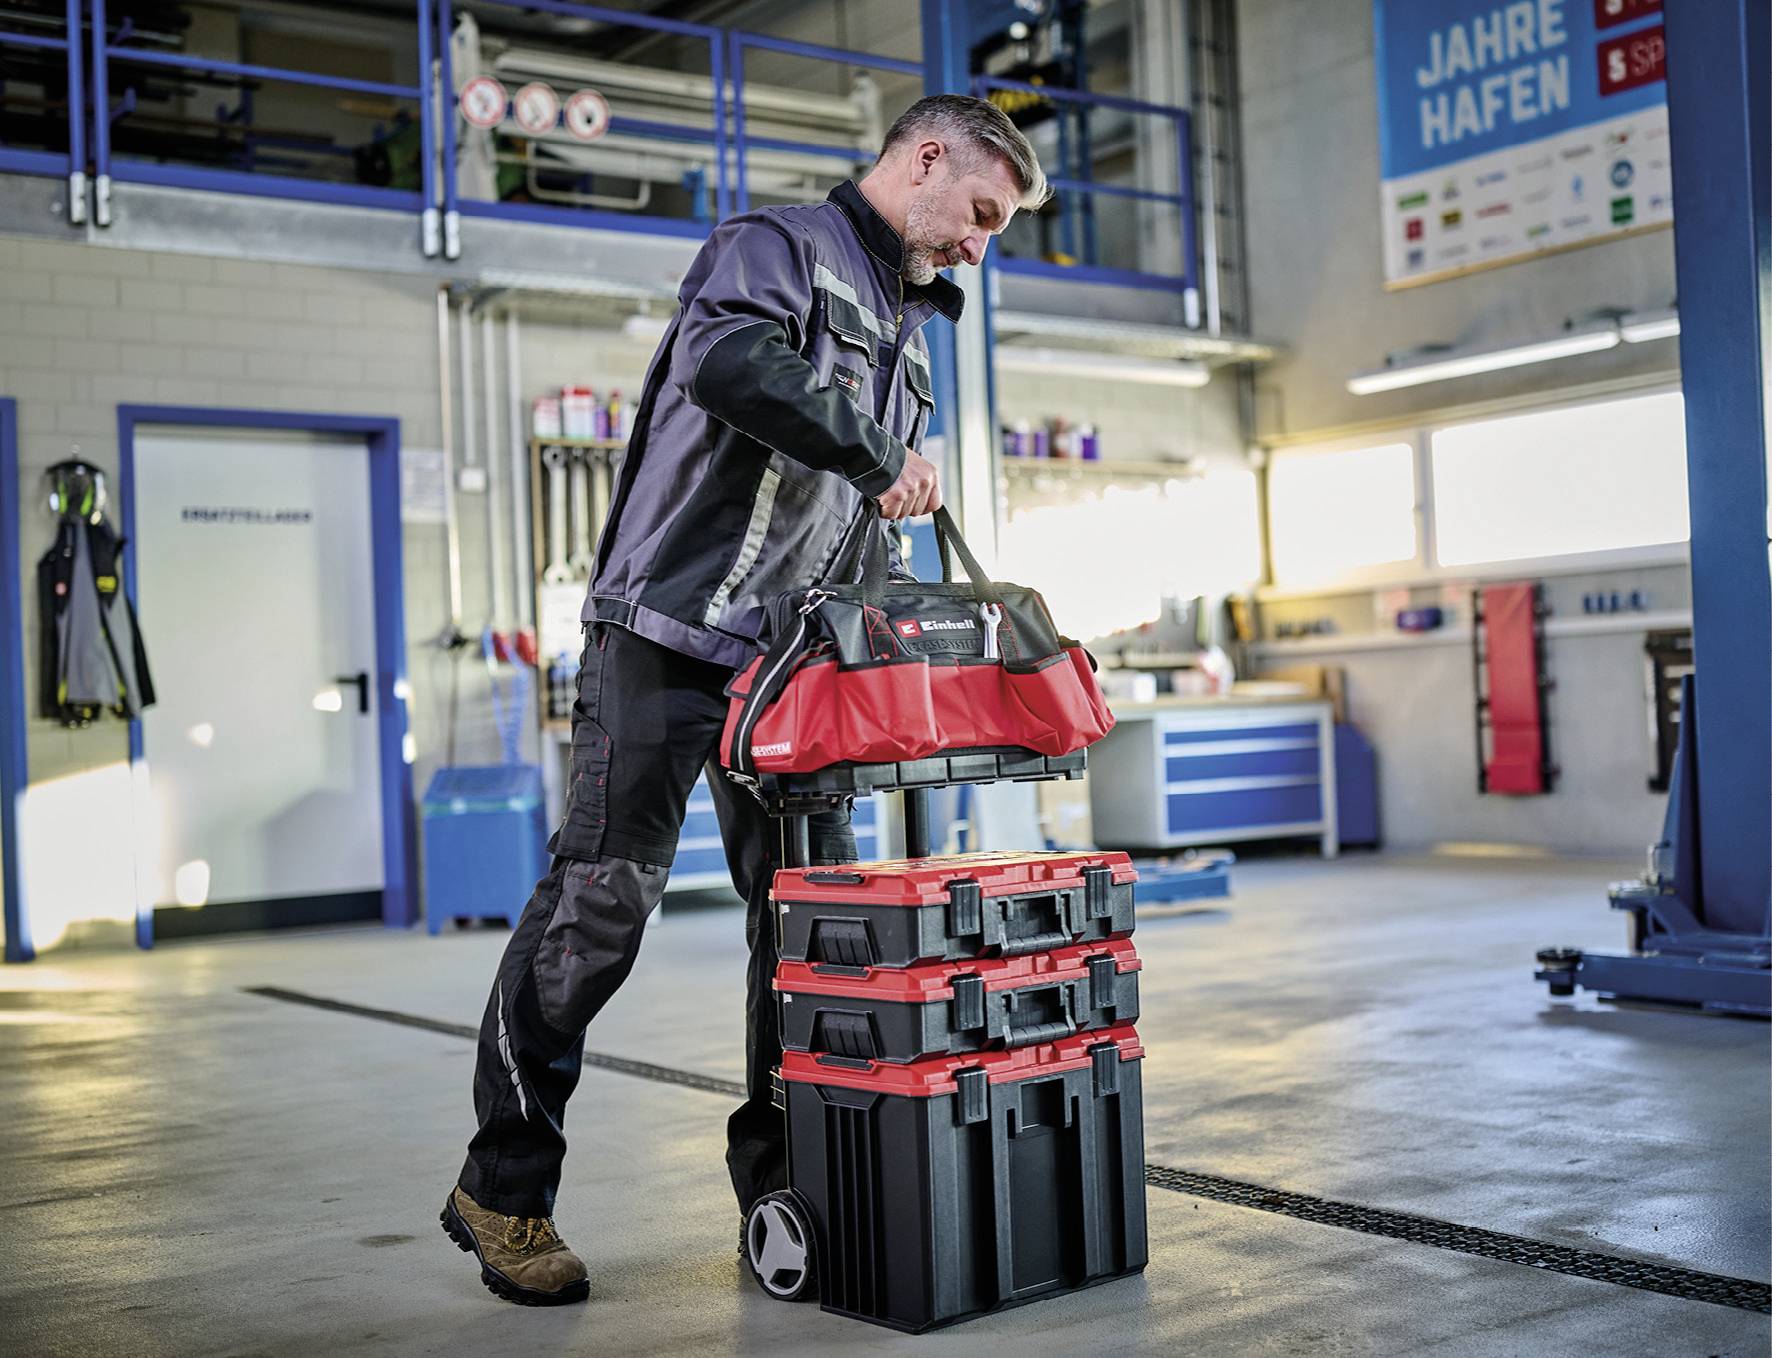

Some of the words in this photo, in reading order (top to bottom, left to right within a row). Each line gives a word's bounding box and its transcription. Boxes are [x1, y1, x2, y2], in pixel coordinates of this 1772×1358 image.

[1416, 0, 1568, 88] JAHRE
[1419, 55, 1570, 149] HAFEN
[919, 619, 976, 631] Einhell
